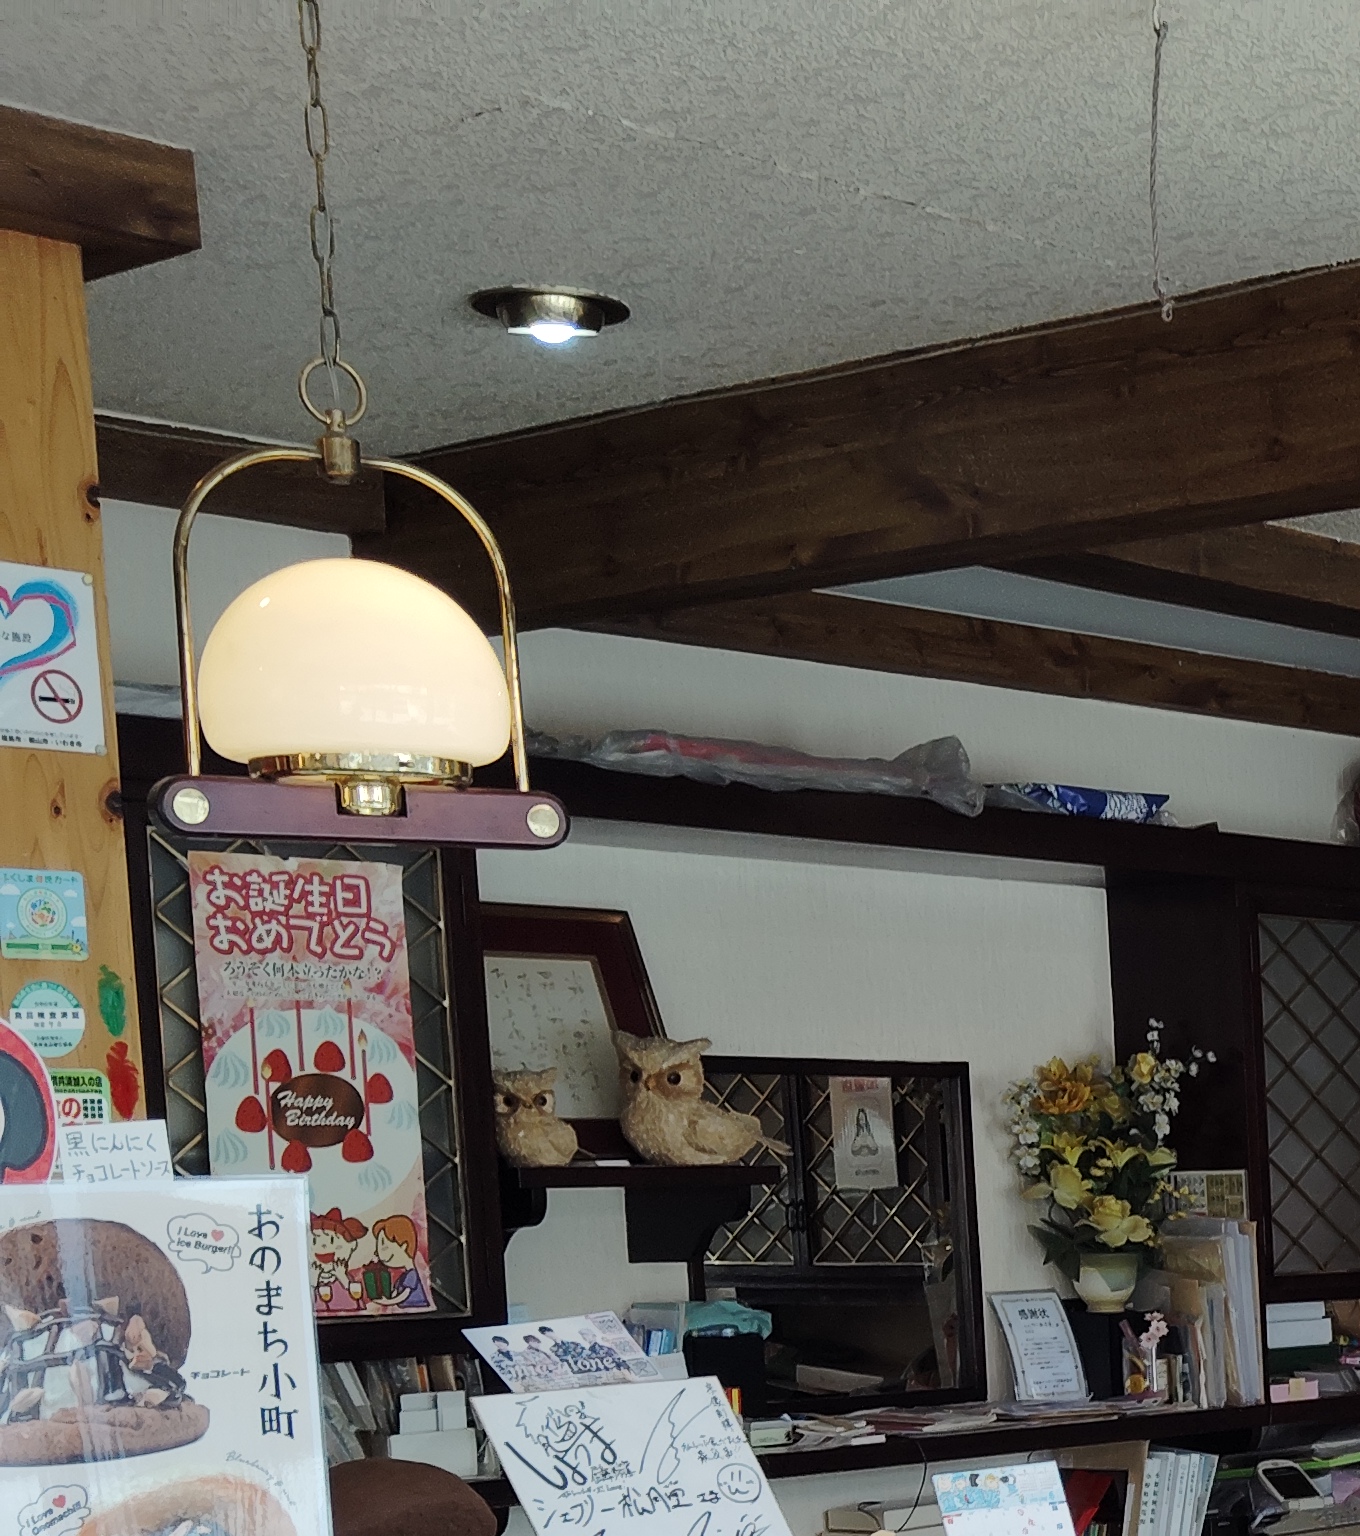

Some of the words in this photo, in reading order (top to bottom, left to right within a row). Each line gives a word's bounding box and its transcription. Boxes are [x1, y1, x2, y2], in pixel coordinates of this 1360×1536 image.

[204, 864, 371, 916] お誕生日
[206, 909, 396, 962] おめでとう
[276, 1090, 334, 1111] Happy
[285, 1109, 356, 1129] Birthday
[248, 1203, 299, 1440] おのまち小町
